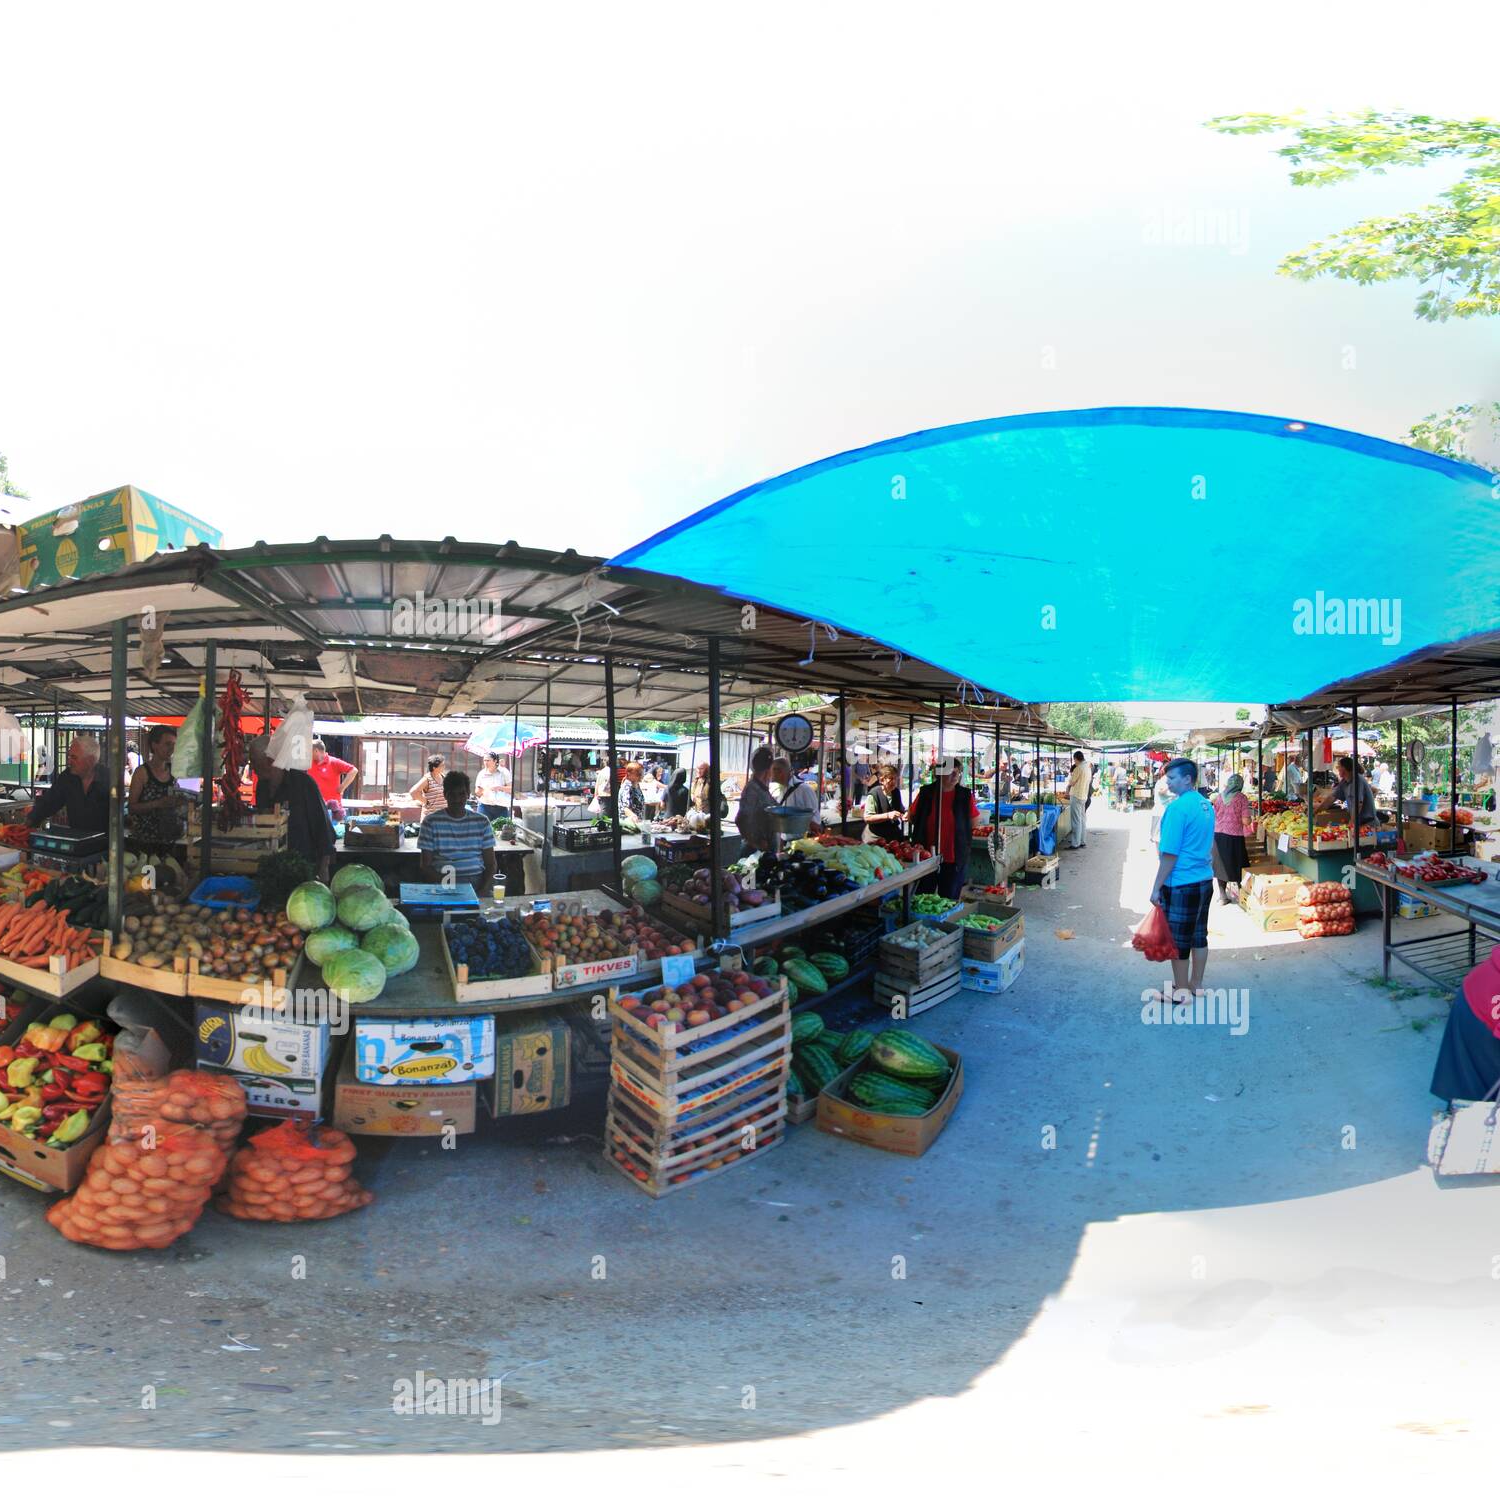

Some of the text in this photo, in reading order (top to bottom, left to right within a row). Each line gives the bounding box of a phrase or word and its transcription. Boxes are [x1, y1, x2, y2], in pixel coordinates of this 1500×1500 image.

[583, 960, 632, 976] TIKVES
[400, 1033, 440, 1042] Bonanza!
[397, 1060, 453, 1076] Bonanza!
[342, 1087, 472, 1099] FIRST QUALITY BANANAS
